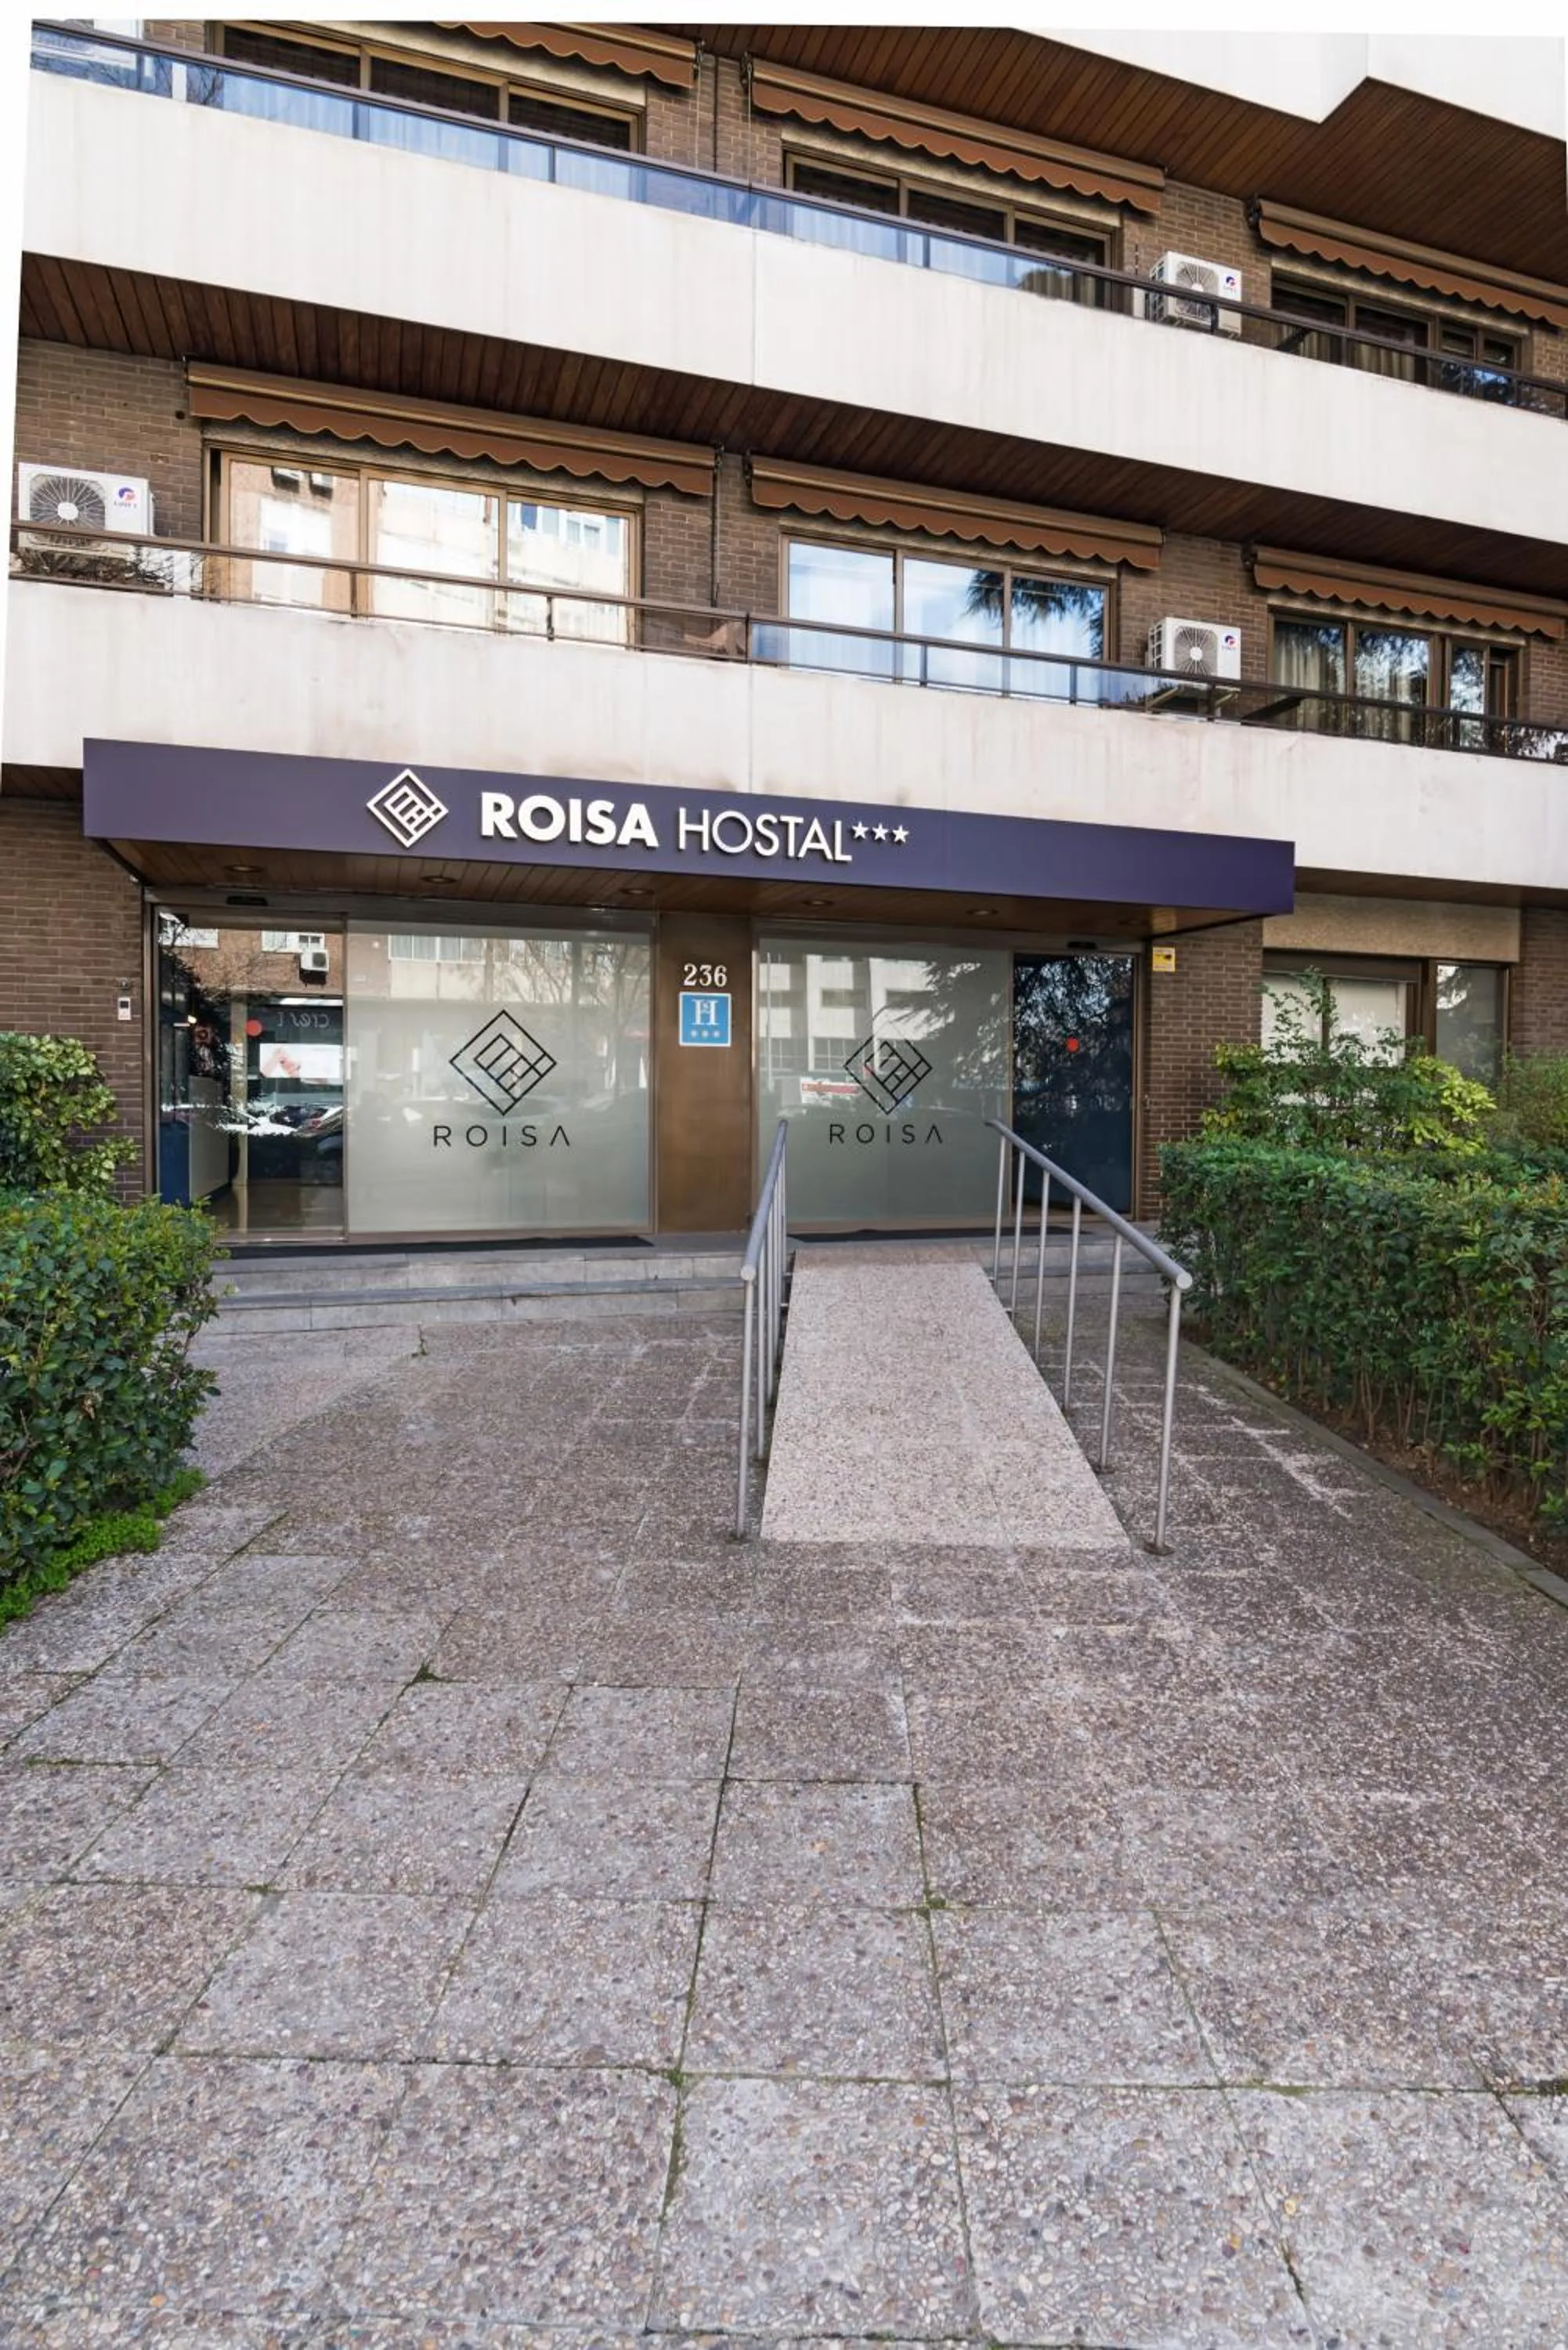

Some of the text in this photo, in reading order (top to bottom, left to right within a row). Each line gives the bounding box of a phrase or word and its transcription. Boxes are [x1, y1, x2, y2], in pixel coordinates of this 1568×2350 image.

[482, 792, 852, 862] ROISA HOSTAL
[683, 963, 728, 987] 236
[433, 1125, 570, 1148] ROISA
[829, 1123, 943, 1144] ROISA
